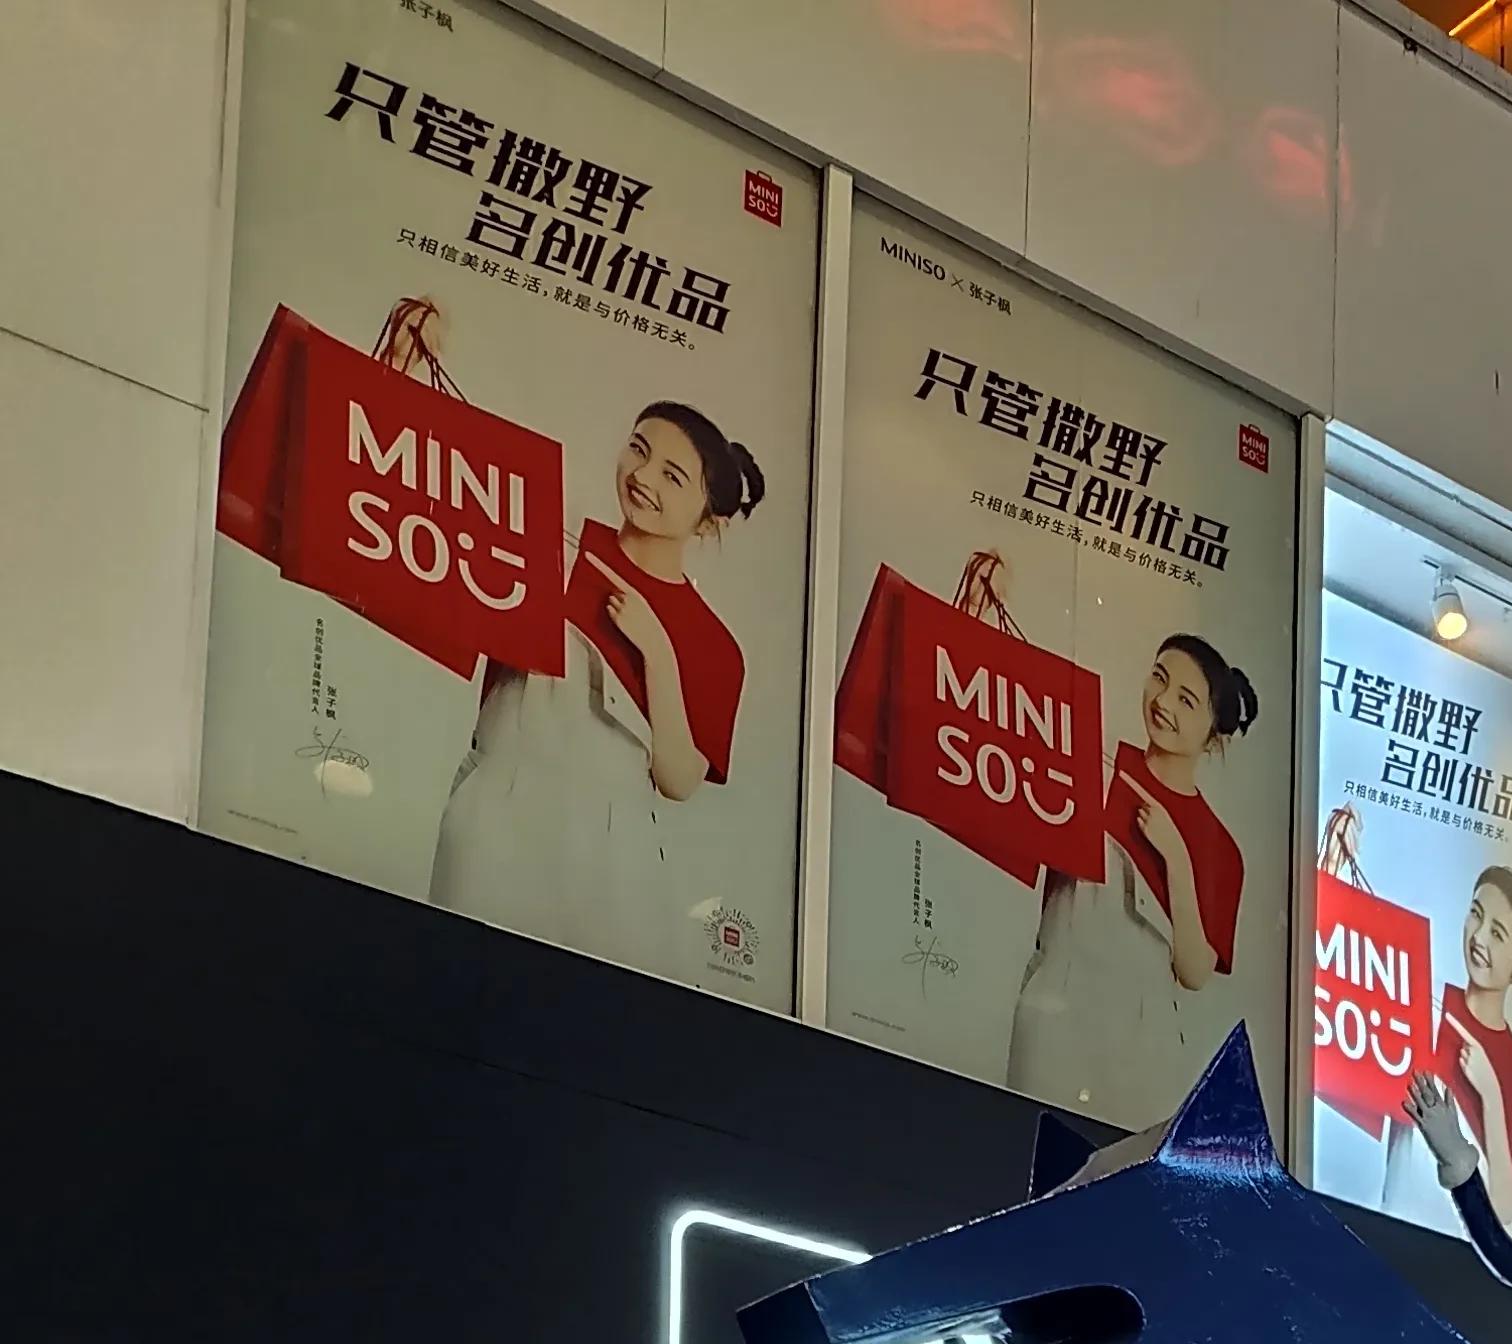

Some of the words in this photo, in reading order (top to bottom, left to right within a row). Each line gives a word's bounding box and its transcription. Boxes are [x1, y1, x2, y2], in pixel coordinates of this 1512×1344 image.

[324, 61, 653, 235] 只管撒野
[749, 179, 779, 205] MINI
[465, 191, 732, 334] 名创优品
[879, 236, 947, 281] MINISO
[969, 281, 1012, 316] 张子枫
[348, 400, 527, 536] MINI
[913, 347, 1169, 489] 只管撒野
[1022, 452, 1231, 572] 名创优品
[935, 644, 1073, 757] MINI
[1321, 657, 1483, 755] 只管撒野
